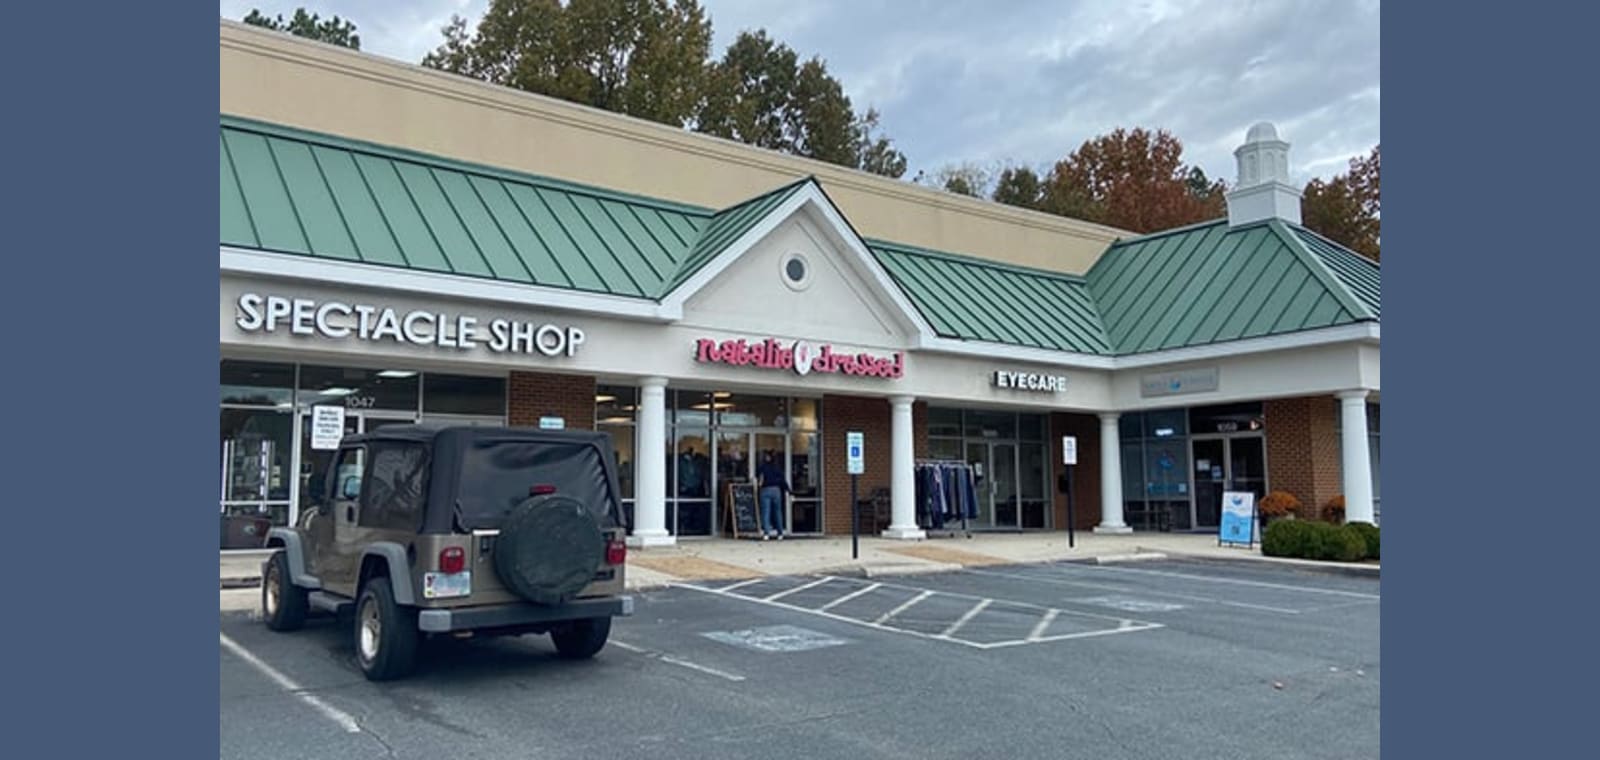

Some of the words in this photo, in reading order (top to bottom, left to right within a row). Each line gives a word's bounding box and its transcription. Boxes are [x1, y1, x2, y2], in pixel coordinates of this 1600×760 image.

[237, 293, 477, 348] SPECTACLE
[489, 318, 586, 357] SHOP
[696, 337, 792, 369] natalie
[813, 344, 904, 379] dressed
[997, 370, 1067, 392] EYECARE
[345, 396, 375, 408] 1047
